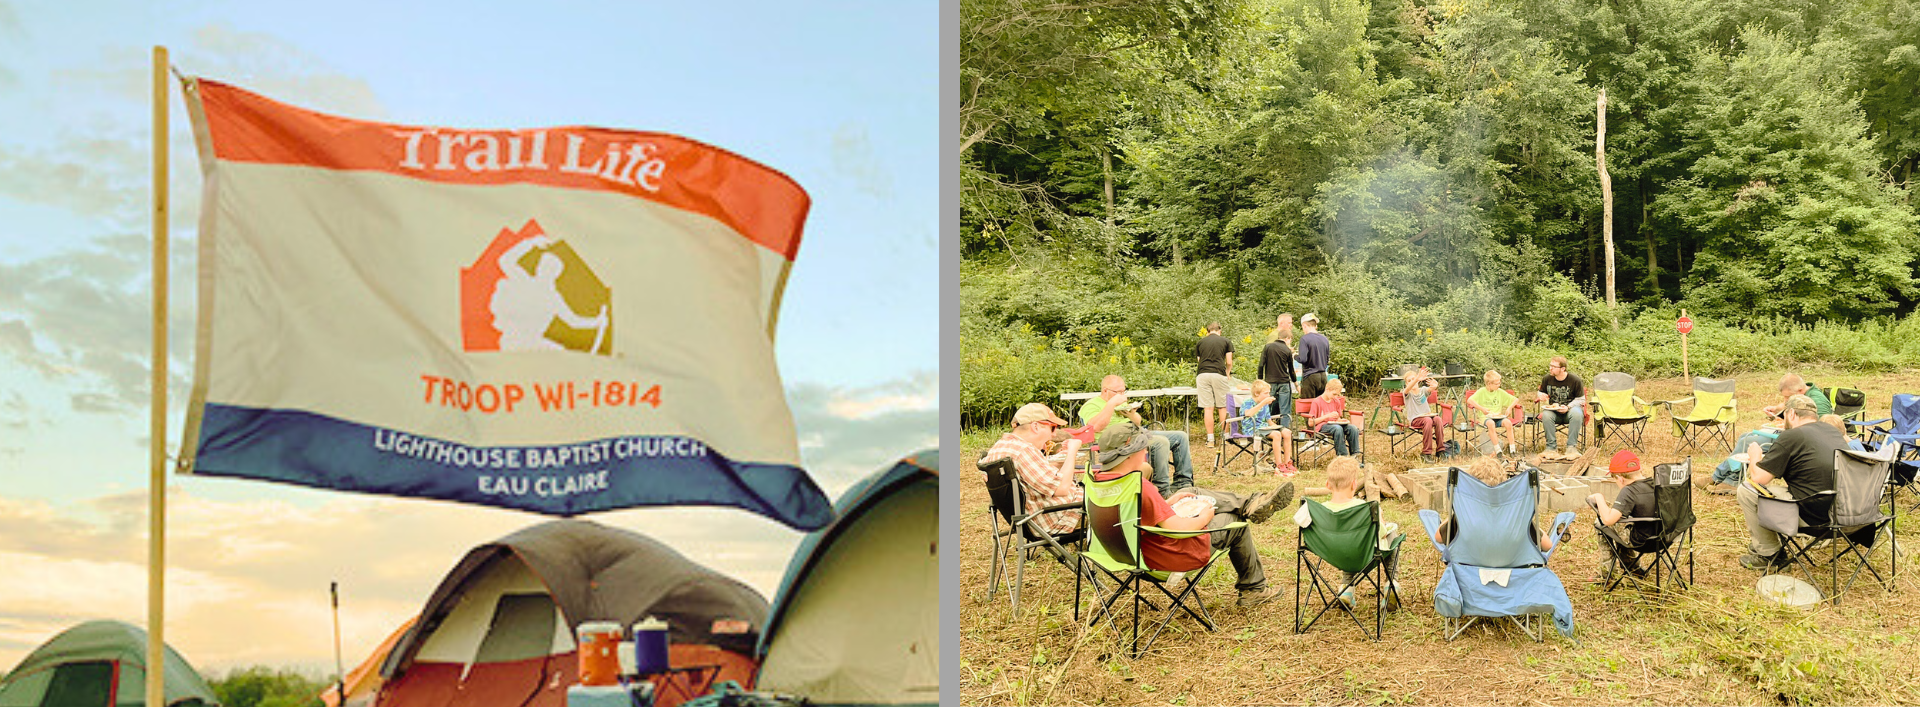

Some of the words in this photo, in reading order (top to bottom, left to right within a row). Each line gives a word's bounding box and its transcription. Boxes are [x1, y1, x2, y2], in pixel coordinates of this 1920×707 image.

[394, 129, 548, 172] Trail
[559, 133, 666, 192] Life
[1677, 321, 1692, 329] STOP
[421, 374, 524, 414] TROOP
[533, 380, 662, 413] WI-1814
[374, 429, 522, 468] LIGHTHOUSE
[526, 441, 611, 469] BAPTIST
[614, 437, 707, 459] CHURCH
[478, 475, 529, 495] EAU
[534, 470, 609, 498] CLAIRE
